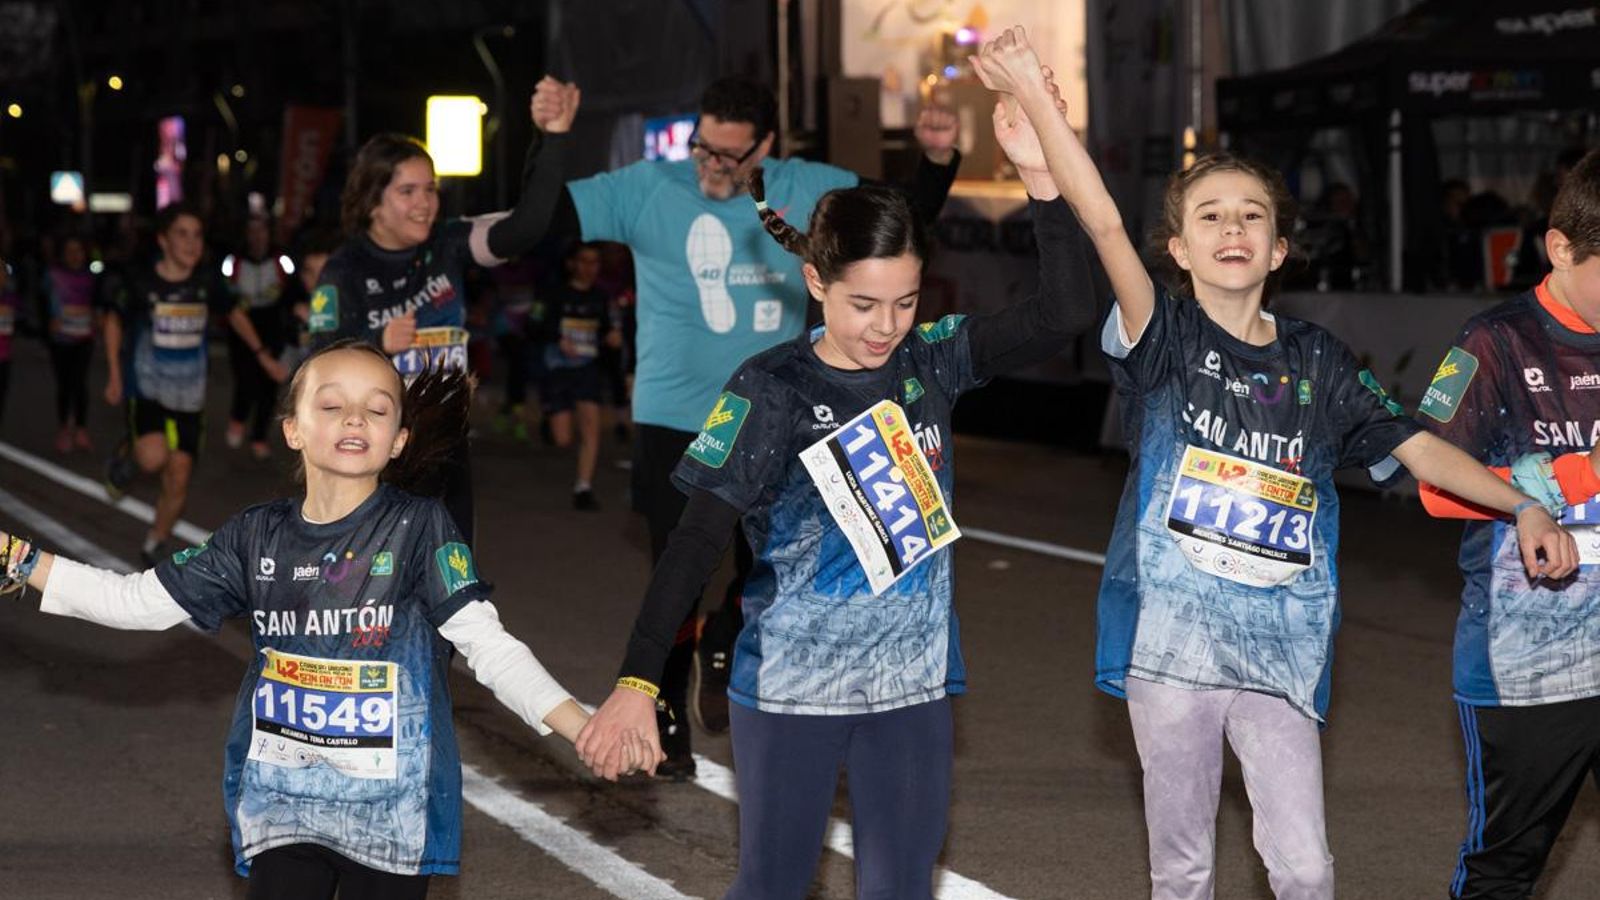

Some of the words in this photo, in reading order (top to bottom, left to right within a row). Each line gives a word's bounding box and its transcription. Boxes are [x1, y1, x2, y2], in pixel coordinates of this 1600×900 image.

[1534, 420, 1584, 447] SAN
[846, 424, 927, 564] 11414
[1180, 484, 1308, 550] 11213
[253, 609, 297, 637] SAN
[304, 598, 394, 637] ANTÓN
[276, 659, 299, 681] 42
[258, 683, 391, 733] 11549
[326, 737, 358, 746] CASTILLO
